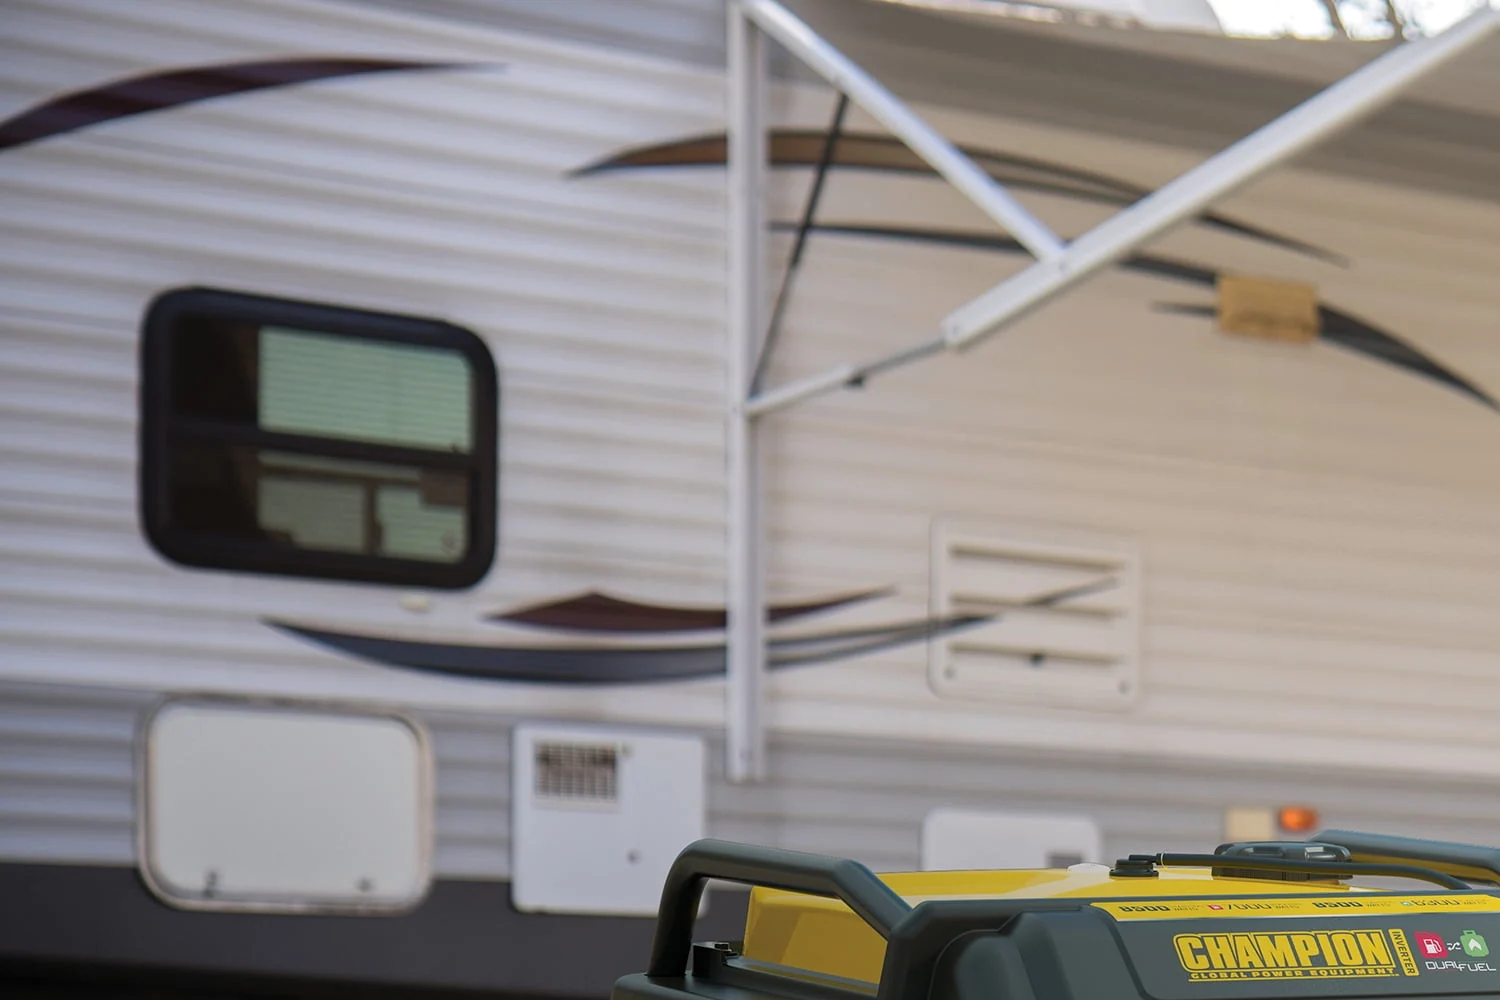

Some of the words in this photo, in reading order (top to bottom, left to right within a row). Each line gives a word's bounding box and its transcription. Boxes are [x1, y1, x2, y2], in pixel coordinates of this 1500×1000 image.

[1176, 932, 1395, 971] CHAMPION
[1391, 930, 1416, 975] INVERTER
[1190, 971, 1247, 980] GLOBAL
[1252, 970, 1304, 978] POWER
[1310, 968, 1396, 977] EQUIPMENT
